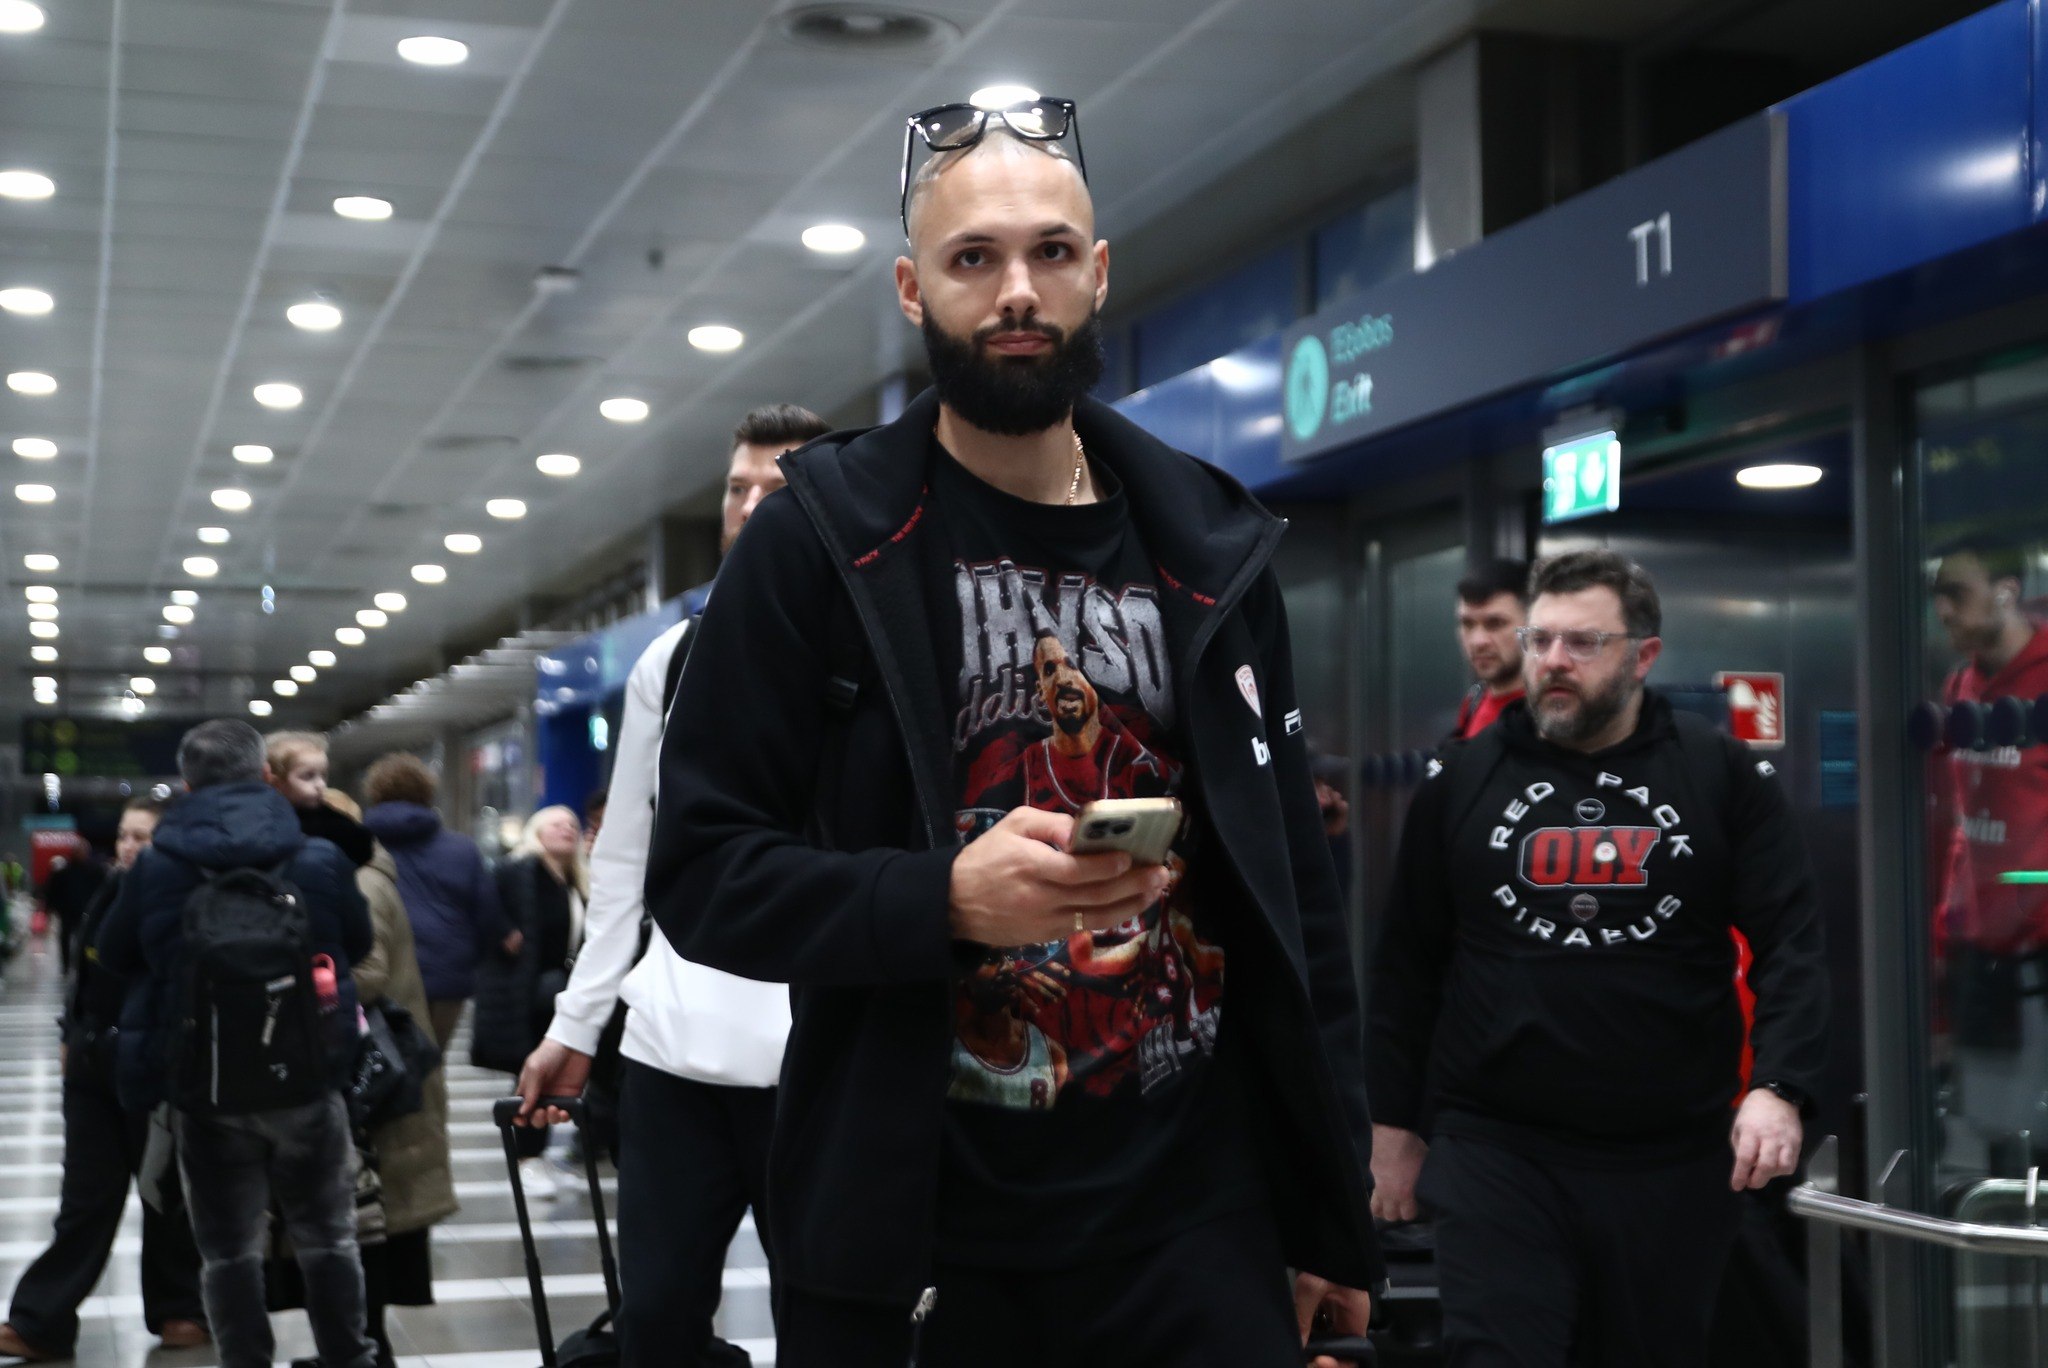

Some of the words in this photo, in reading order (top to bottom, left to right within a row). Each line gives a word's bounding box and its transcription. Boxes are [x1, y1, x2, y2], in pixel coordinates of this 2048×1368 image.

[1489, 781, 1555, 850] RED
[1596, 771, 1694, 860] PACK
[1522, 827, 1660, 887] OLY
[1492, 884, 1682, 949] PIRAEUS
